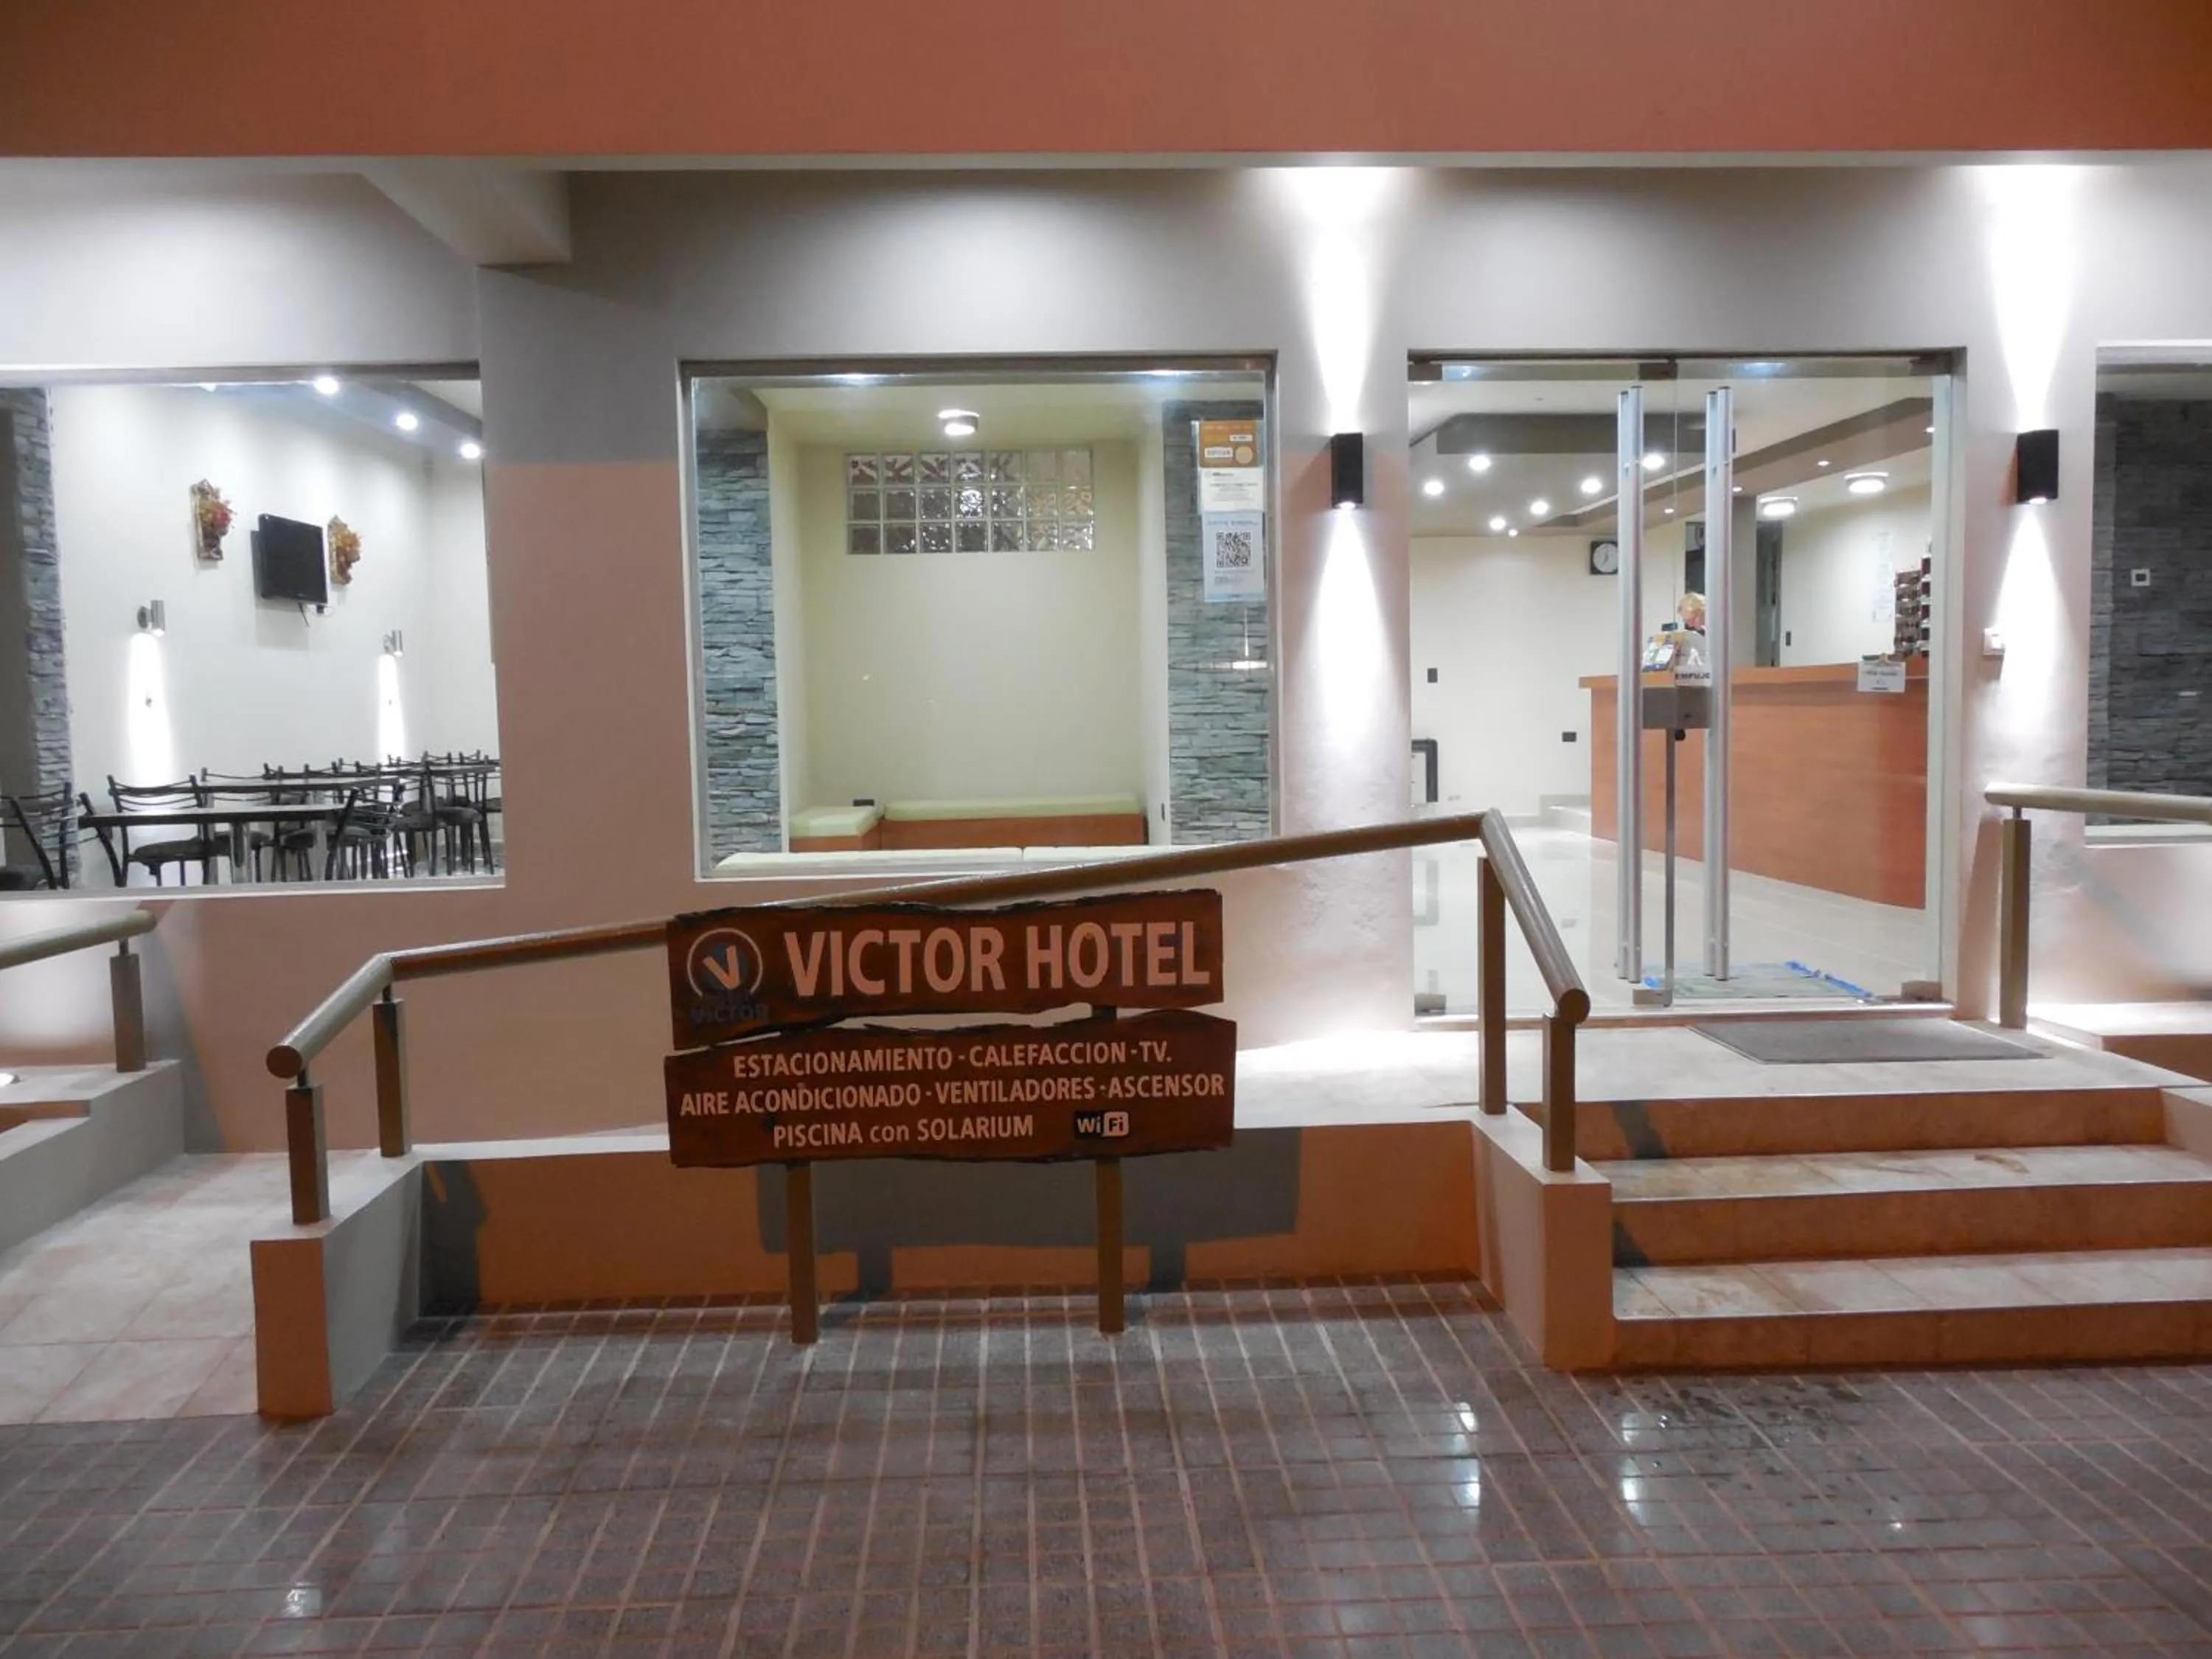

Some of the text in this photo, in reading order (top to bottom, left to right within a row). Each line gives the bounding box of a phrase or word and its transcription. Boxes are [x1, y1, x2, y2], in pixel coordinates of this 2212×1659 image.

[783, 921, 1211, 998] VICTOR HOTEL
[732, 1046, 953, 1079] ESTACIONAMIENTO
[969, 1041, 1127, 1068] CALEFACCION
[680, 1091, 729, 1116] AIRE
[734, 1082, 922, 1115] ACONDICIONADO
[935, 1077, 1096, 1105] VENTILADORES
[1107, 1073, 1225, 1099] ASCENSOR
[773, 1114, 1034, 1148] PISCINA con SOLARIUM
